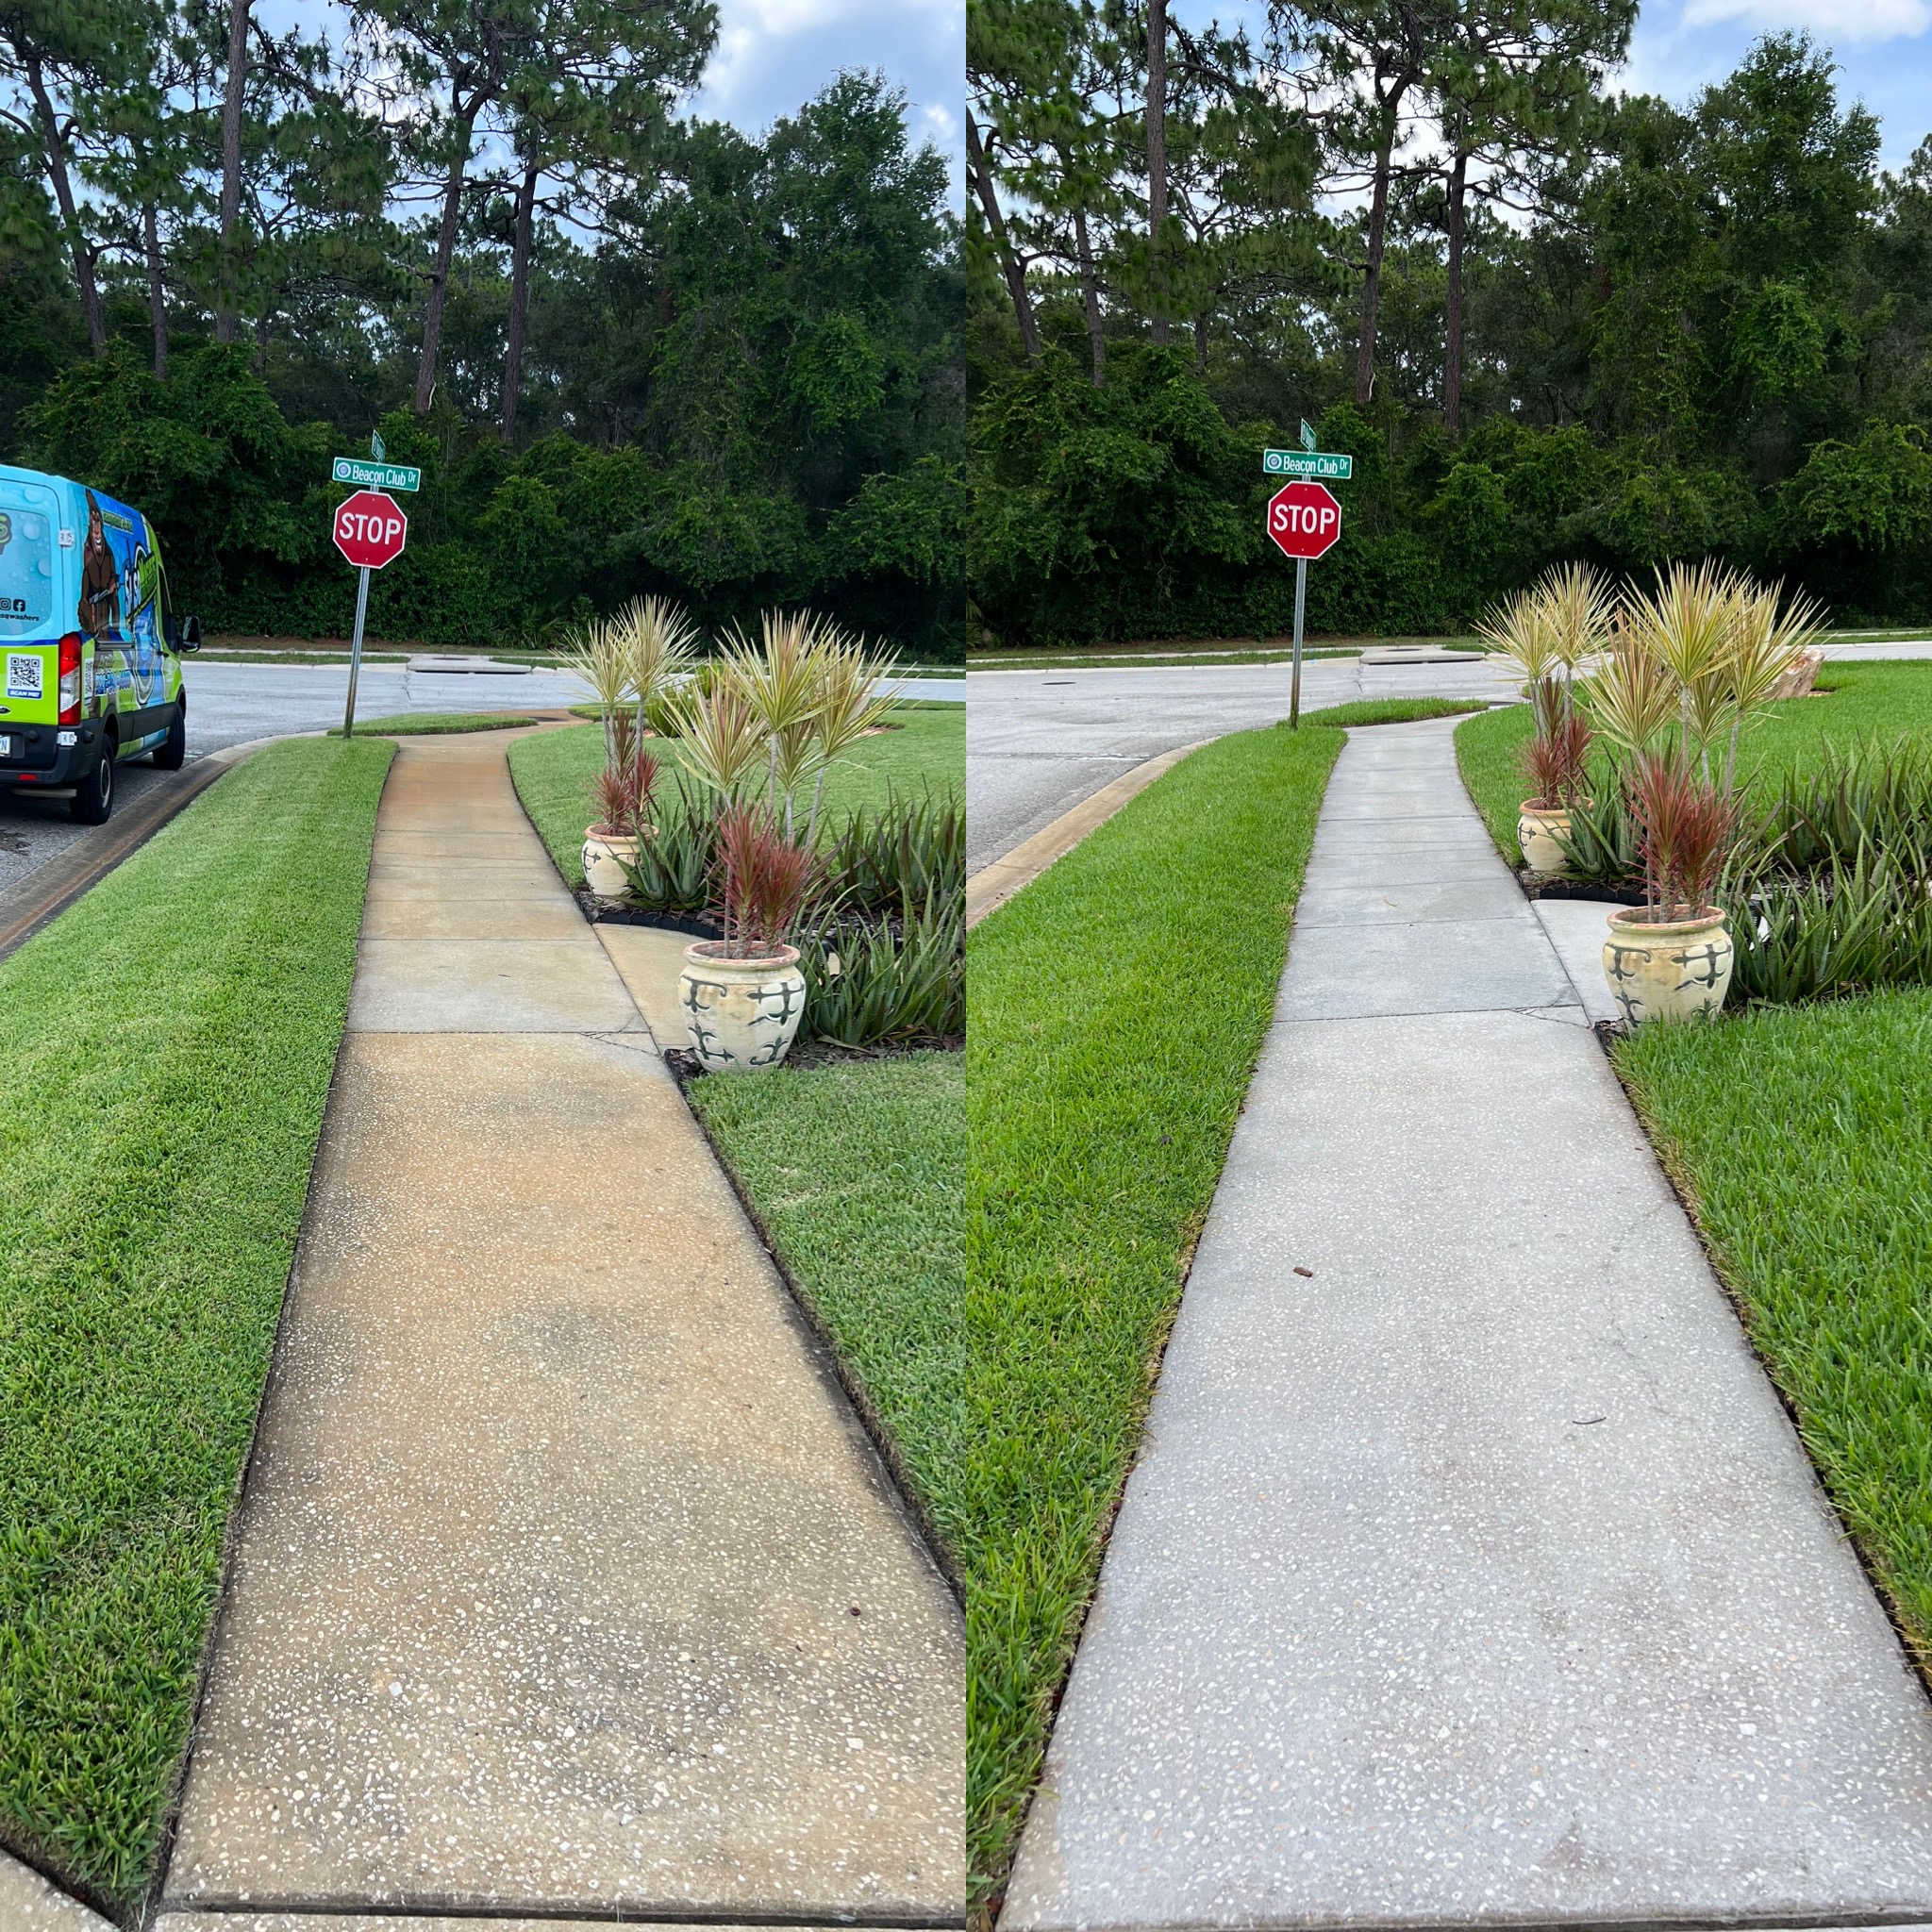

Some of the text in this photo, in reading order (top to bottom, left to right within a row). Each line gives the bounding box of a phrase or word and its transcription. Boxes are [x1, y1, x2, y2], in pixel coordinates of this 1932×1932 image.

[352, 464, 416, 487] Beacon Club Dr
[1283, 456, 1348, 475] Beacon Club Dr
[339, 511, 402, 545] STOP
[1273, 503, 1336, 535] STOP
[0, 613, 40, 622] sqwashers
